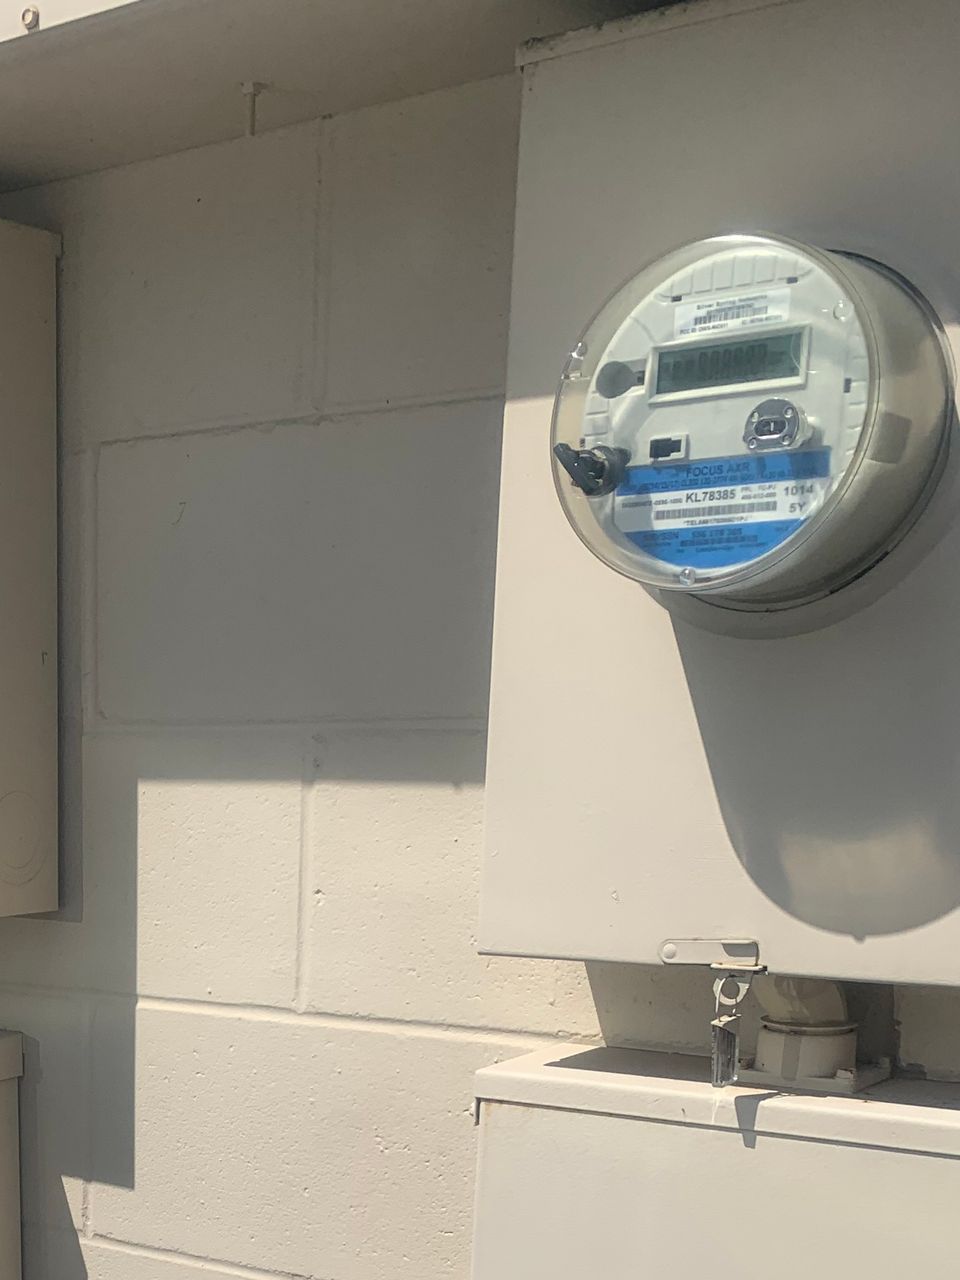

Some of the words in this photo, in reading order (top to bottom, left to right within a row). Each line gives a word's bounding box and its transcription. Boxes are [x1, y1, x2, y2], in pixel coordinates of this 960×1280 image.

[686, 464, 723, 478] FOCUS
[685, 489, 736, 503] KL78385
[784, 484, 814, 496] 1014
